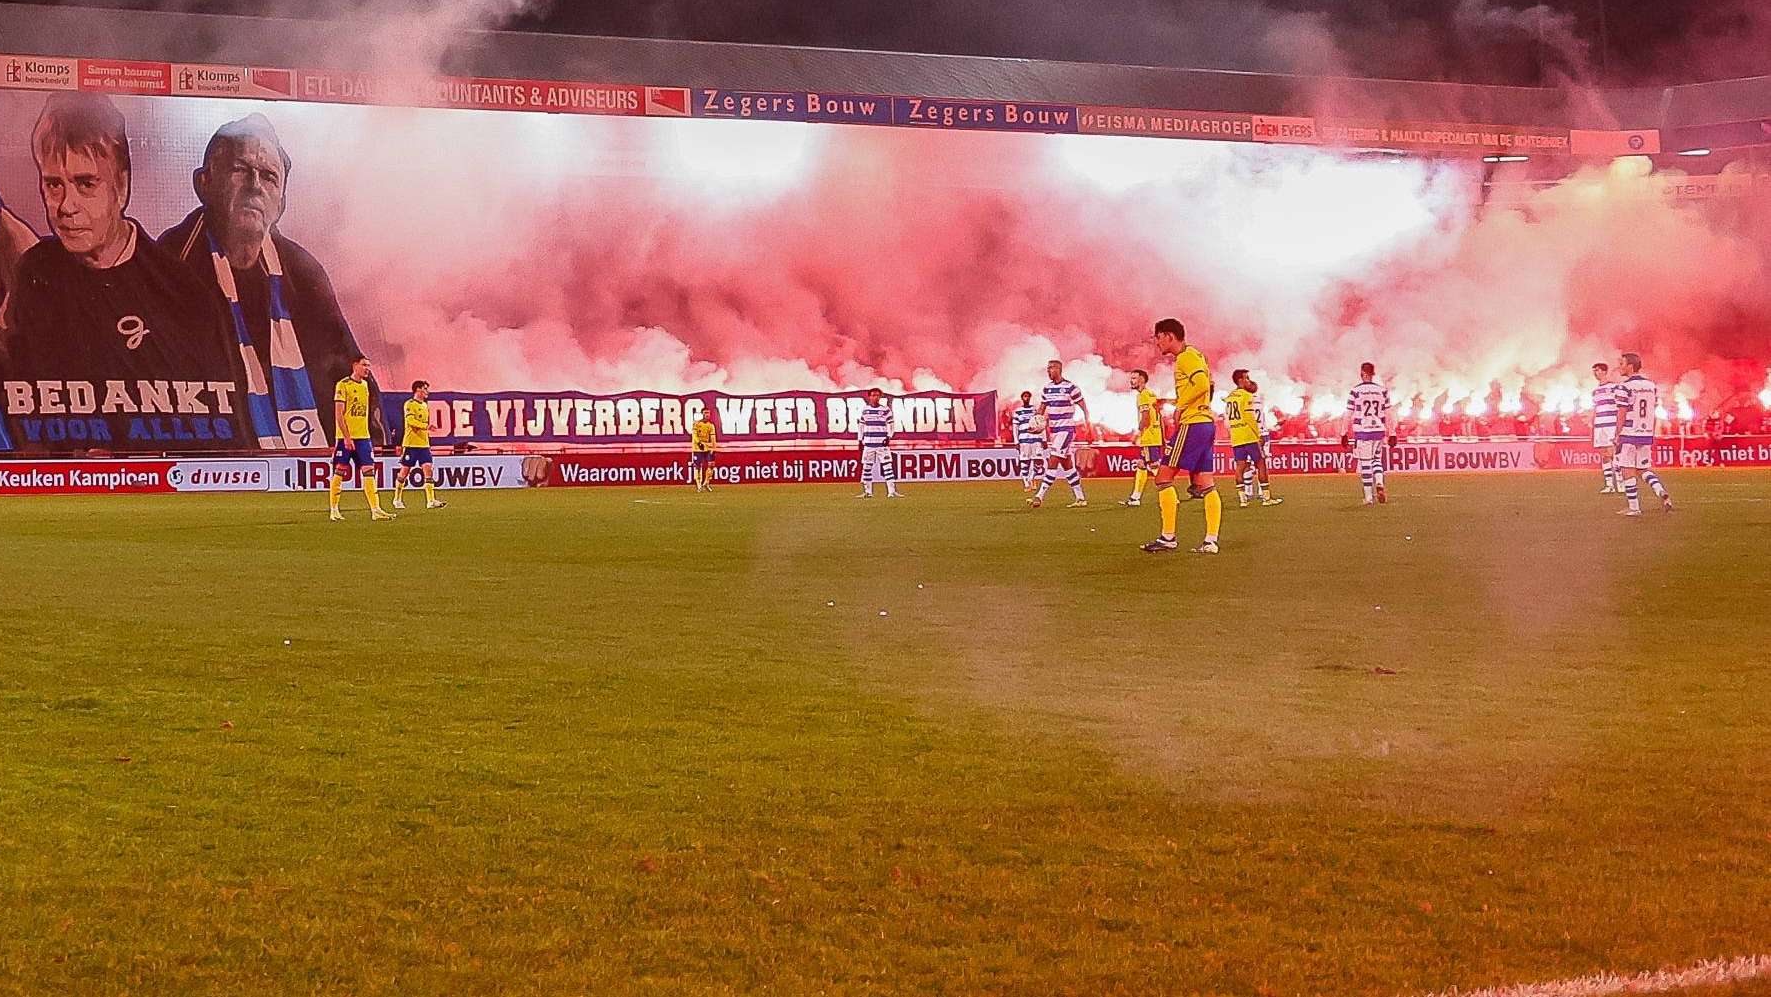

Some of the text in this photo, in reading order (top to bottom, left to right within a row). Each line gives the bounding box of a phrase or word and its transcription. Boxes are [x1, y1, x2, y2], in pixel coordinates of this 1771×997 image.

[25, 61, 70, 76] Klomps
[197, 69, 240, 83] Klomps
[530, 86, 543, 105] &
[546, 88, 638, 109] ADVISEURS
[704, 89, 876, 116] Zegers Bouw
[909, 98, 1070, 125] Zegers Bouw
[1098, 114, 1250, 136] EISMA MEDIAGROEP
[4, 380, 236, 414] BEDANKT
[1362, 399, 1381, 417] 23
[428, 397, 977, 437] DE VIJVERBERG WEER BRNDEN
[1226, 401, 1242, 421] 28
[1639, 398, 1648, 419] 8
[21, 417, 234, 441] VOOR ALLES
[900, 453, 962, 479] RPM
[1291, 452, 1309, 473] bij
[1312, 452, 1354, 469] RPM?
[1389, 446, 1440, 470] RPM
[1560, 449, 1601, 464] Waaro
[1655, 445, 1674, 465] jij
[1720, 445, 1755, 461] niet
[69, 469, 160, 489] Kampioen
[559, 461, 636, 483] Waarom
[640, 460, 684, 480] werk
[745, 460, 779, 479] niet
[783, 460, 804, 481] bij
[808, 459, 858, 478] RPM?
